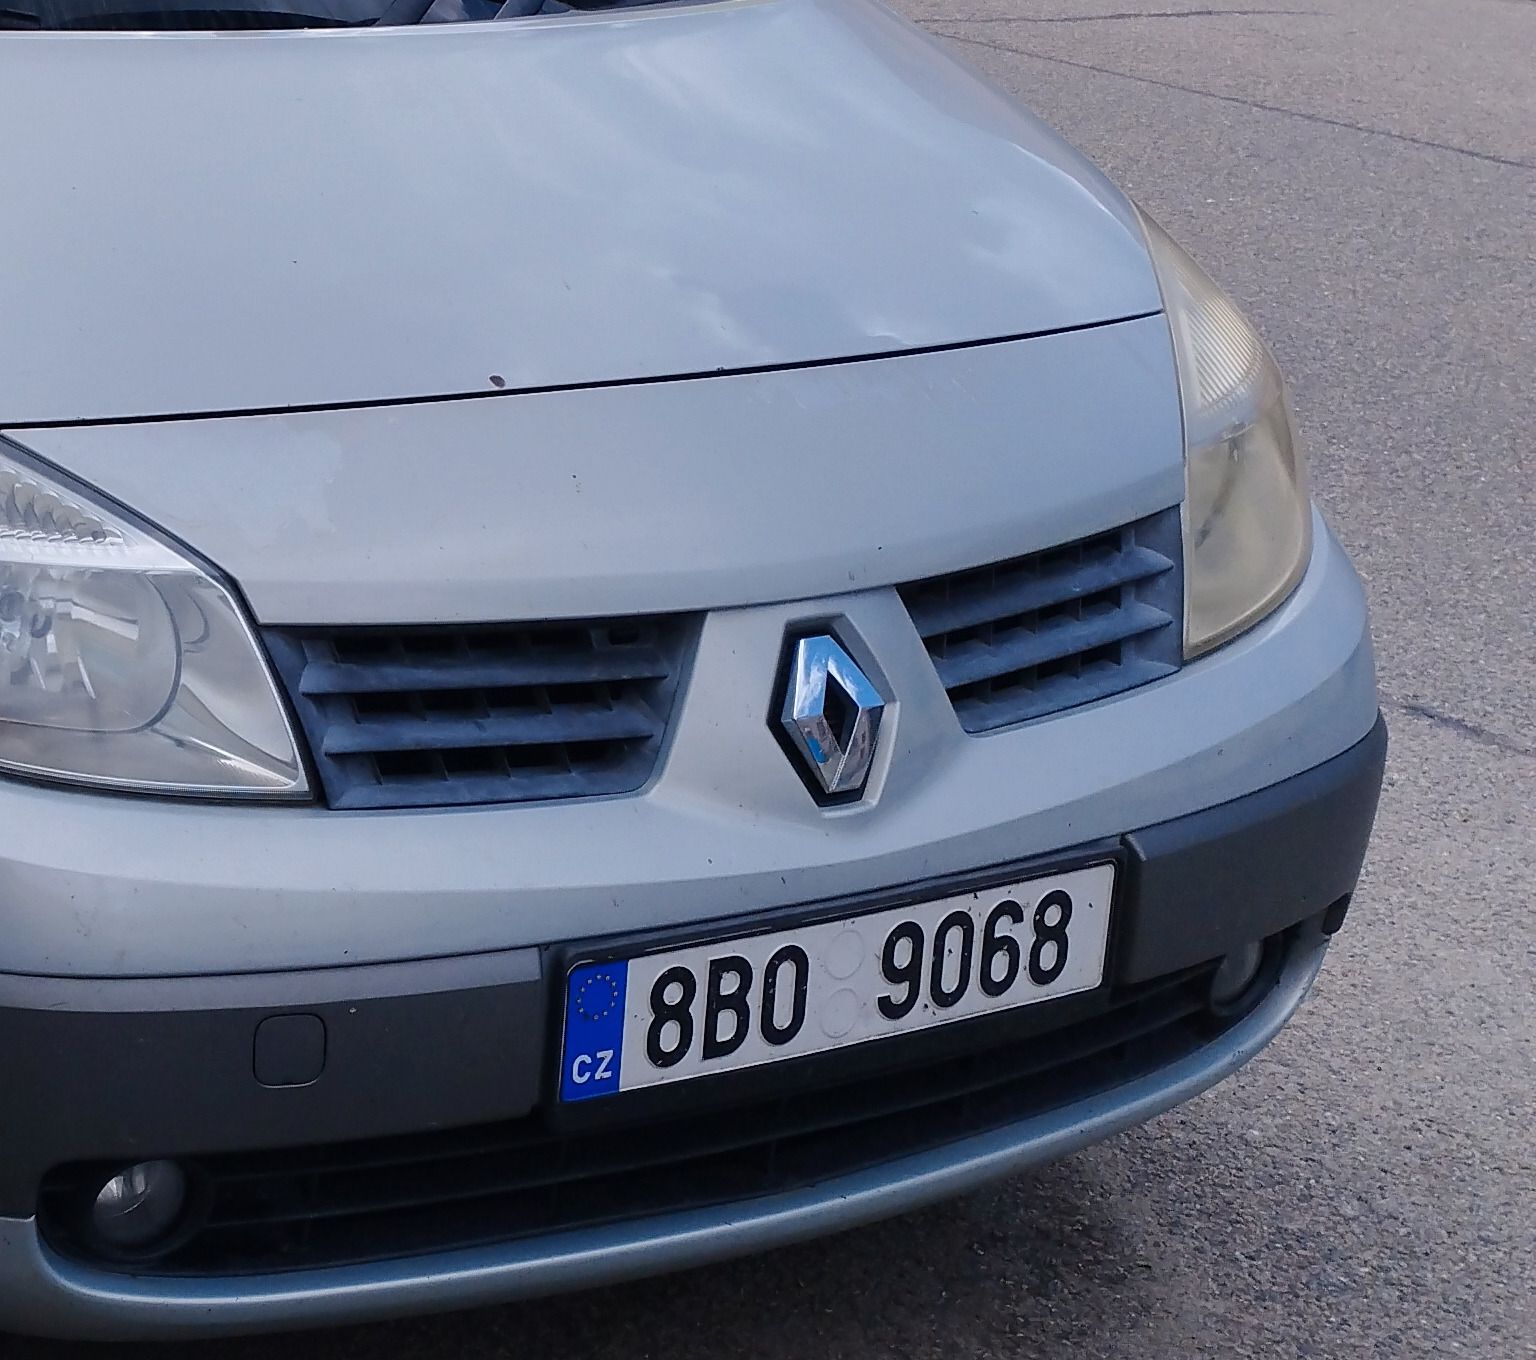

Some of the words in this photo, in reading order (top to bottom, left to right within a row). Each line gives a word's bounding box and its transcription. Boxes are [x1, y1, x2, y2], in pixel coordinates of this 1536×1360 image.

[646, 944, 809, 1069] 8B0
[877, 890, 1073, 1021] 9068
[571, 1049, 614, 1084] CZ
